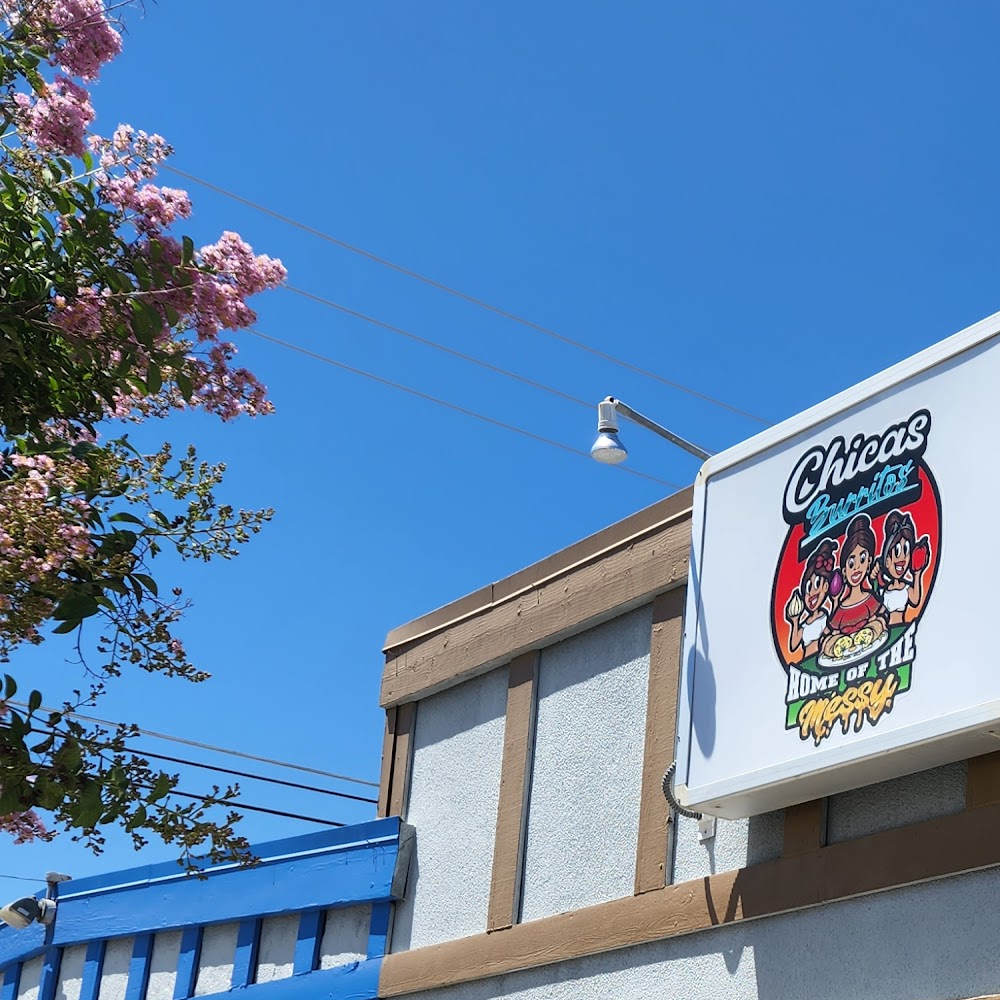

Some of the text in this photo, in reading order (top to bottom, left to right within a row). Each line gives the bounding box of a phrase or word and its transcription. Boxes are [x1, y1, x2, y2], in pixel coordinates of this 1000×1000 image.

[785, 414, 928, 513] Chicas
[805, 459, 917, 537] Burritos
[787, 621, 917, 702] HOME OF THE
